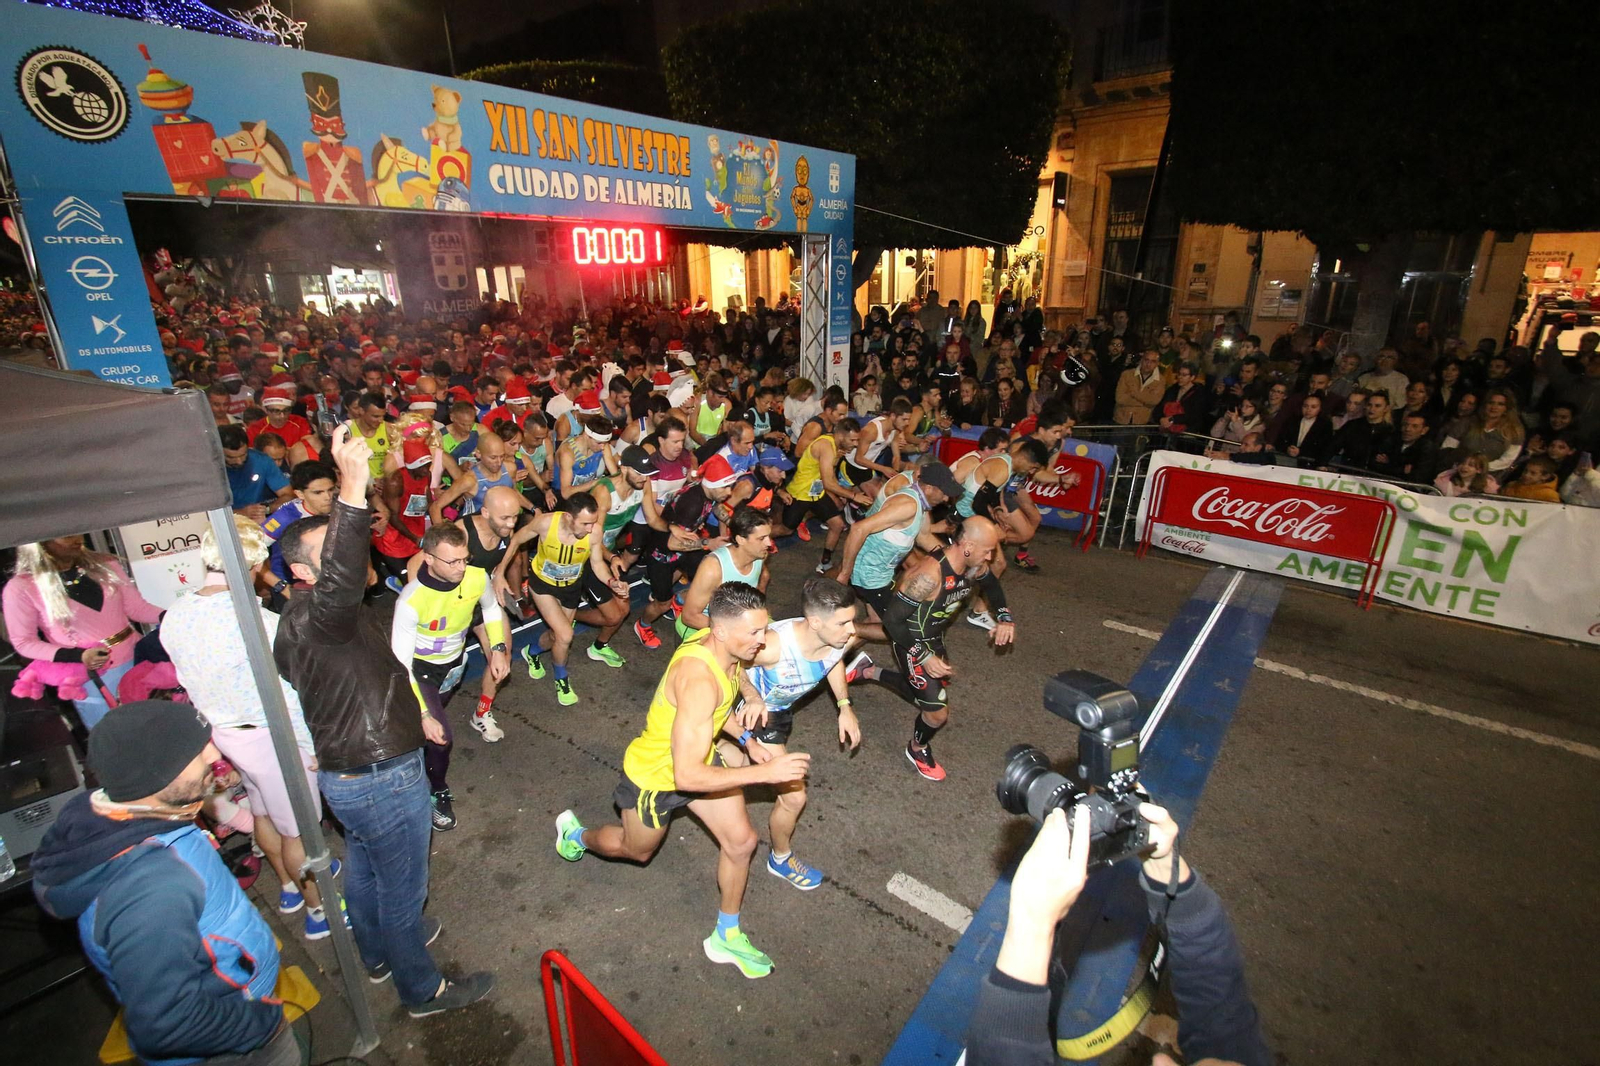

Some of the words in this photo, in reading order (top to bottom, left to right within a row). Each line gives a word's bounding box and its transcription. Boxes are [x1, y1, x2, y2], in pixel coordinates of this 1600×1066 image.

[26, 63, 39, 98] DISEÑADO
[38, 54, 52, 66] POR
[482, 99, 531, 156] XII
[532, 108, 581, 163] SAN
[583, 117, 691, 177] SILVESTRE
[488, 163, 579, 200] CIUDAD
[582, 173, 611, 203] DE
[614, 178, 693, 211] ALMERÍA
[818, 198, 848, 211] ALMERÍA
[823, 210, 845, 221] CIUDAD
[1025, 226, 1045, 237] GO
[86, 293, 114, 302] OPEL
[79, 348, 91, 357] DS
[94, 344, 152, 356] AUTOMOBILES
[101, 364, 141, 377] GRUPO
[136, 374, 161, 385] CAR
[1191, 486, 1347, 543] Coca-Cola
[1449, 502, 1528, 528] CON
[1163, 527, 1212, 542] AMBIENTE
[141, 534, 201, 556] DUNA
[1161, 535, 1208, 555] Coca-Cola
[1376, 511, 1522, 584] EN
[1276, 552, 1501, 618] AMBENTE
[1086, 1030, 1112, 1049] Nikon
